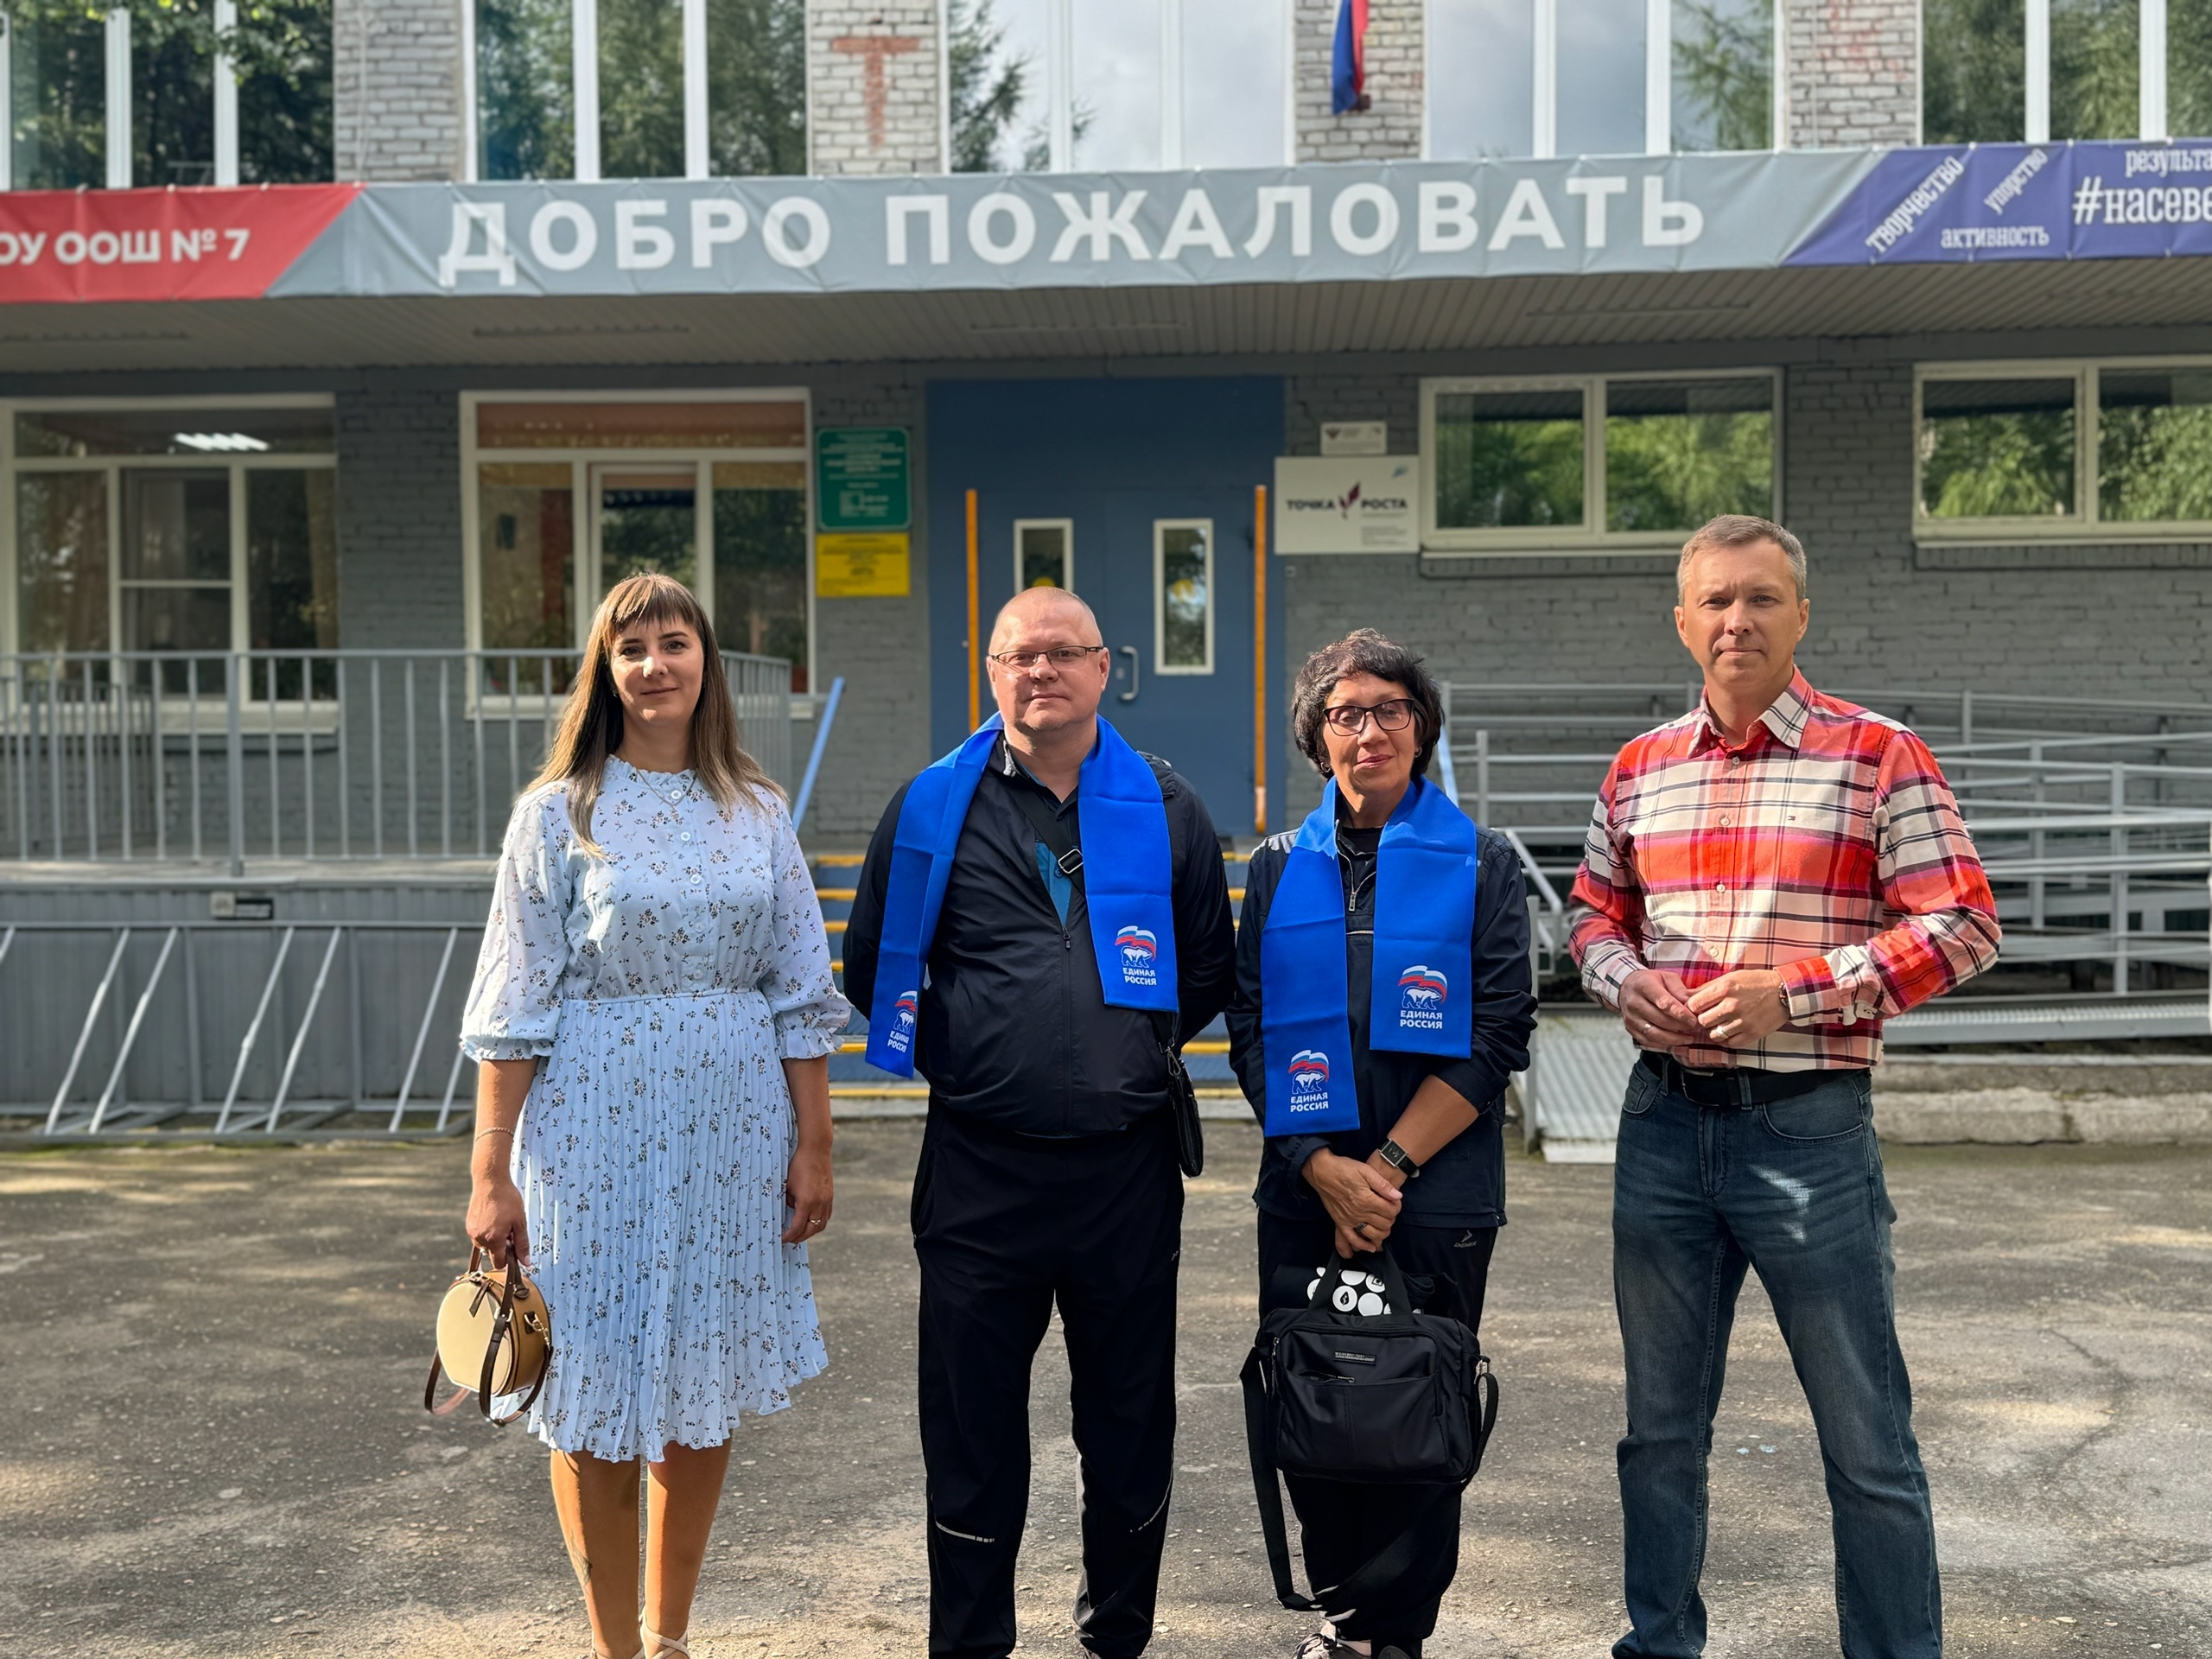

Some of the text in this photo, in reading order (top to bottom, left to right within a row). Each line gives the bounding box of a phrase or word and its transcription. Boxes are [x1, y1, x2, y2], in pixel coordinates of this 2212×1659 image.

[2125, 148, 2212, 178] результа
[1983, 148, 2049, 215] упорство
[1865, 156, 1964, 254] творчество
[438, 175, 1704, 287] ДОБРО ПОЖАЛОВАТЬ
[1941, 226, 2050, 249] активность
[54, 228, 161, 265] ООШ
[172, 228, 218, 262] №
[226, 228, 251, 261] 7
[1286, 499, 1408, 511] ТОЧКА РОСТА
[1122, 967, 1155, 977] ЕДИНАЯ
[1124, 976, 1157, 986] РОССИЯ
[1400, 1010, 1443, 1020] ЕДИНАЯ
[1400, 1019, 1443, 1029] РОССИЯ
[1290, 1092, 1328, 1104] ЕДИНАЯ
[1290, 1101, 1329, 1113] РОССИЯ
